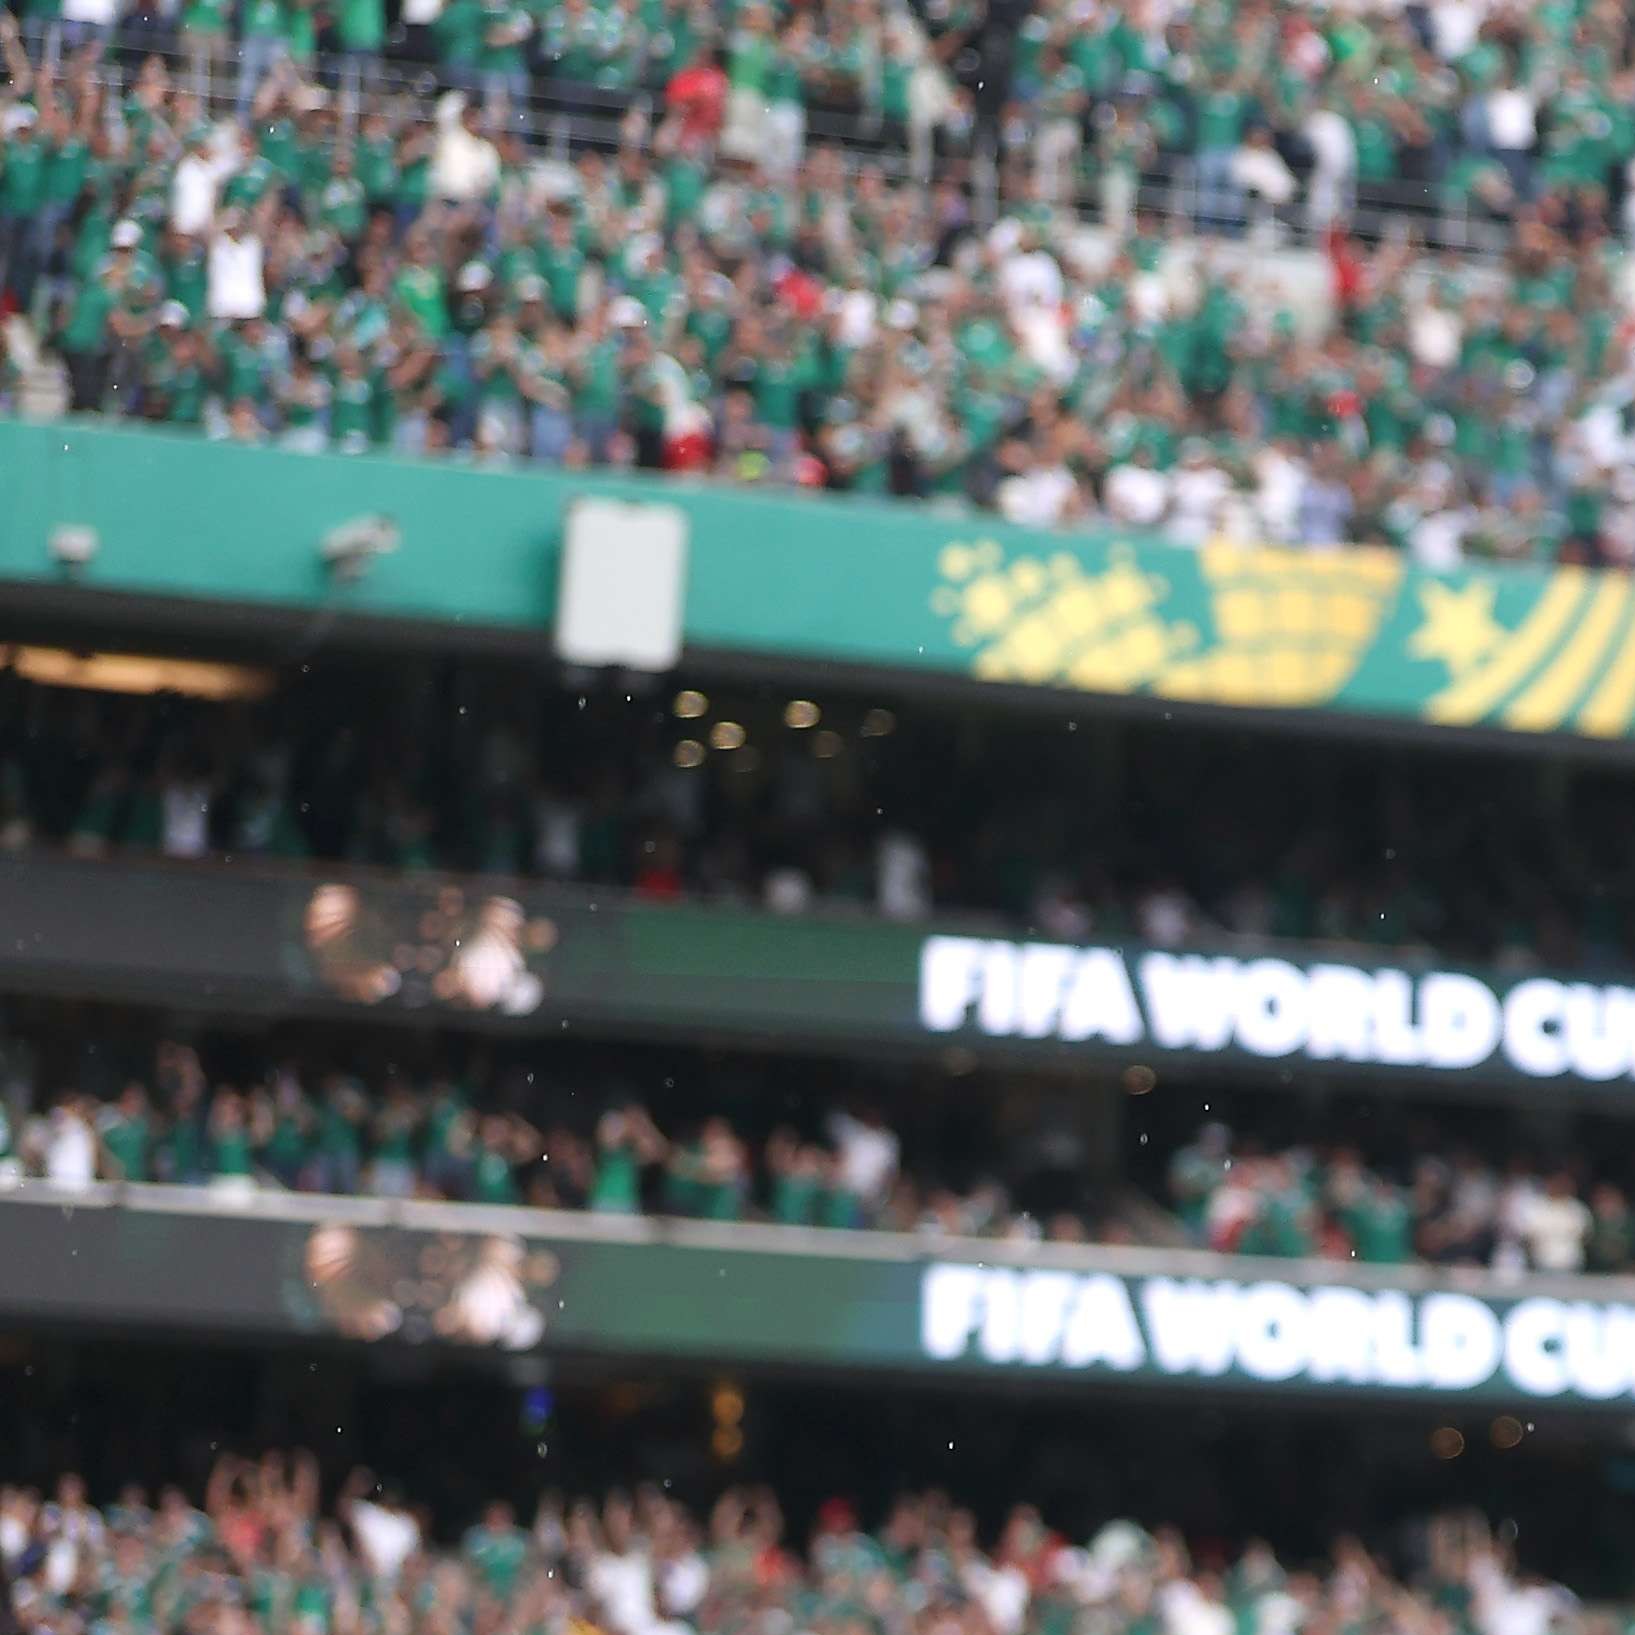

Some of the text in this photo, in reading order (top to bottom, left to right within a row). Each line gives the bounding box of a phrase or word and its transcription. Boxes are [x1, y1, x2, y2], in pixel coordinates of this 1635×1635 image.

[919, 935, 1142, 1044] FIFA
[1140, 953, 1502, 1070] WORLD
[919, 1262, 1142, 1370] FIFA
[1142, 1279, 1504, 1391] WORLD
